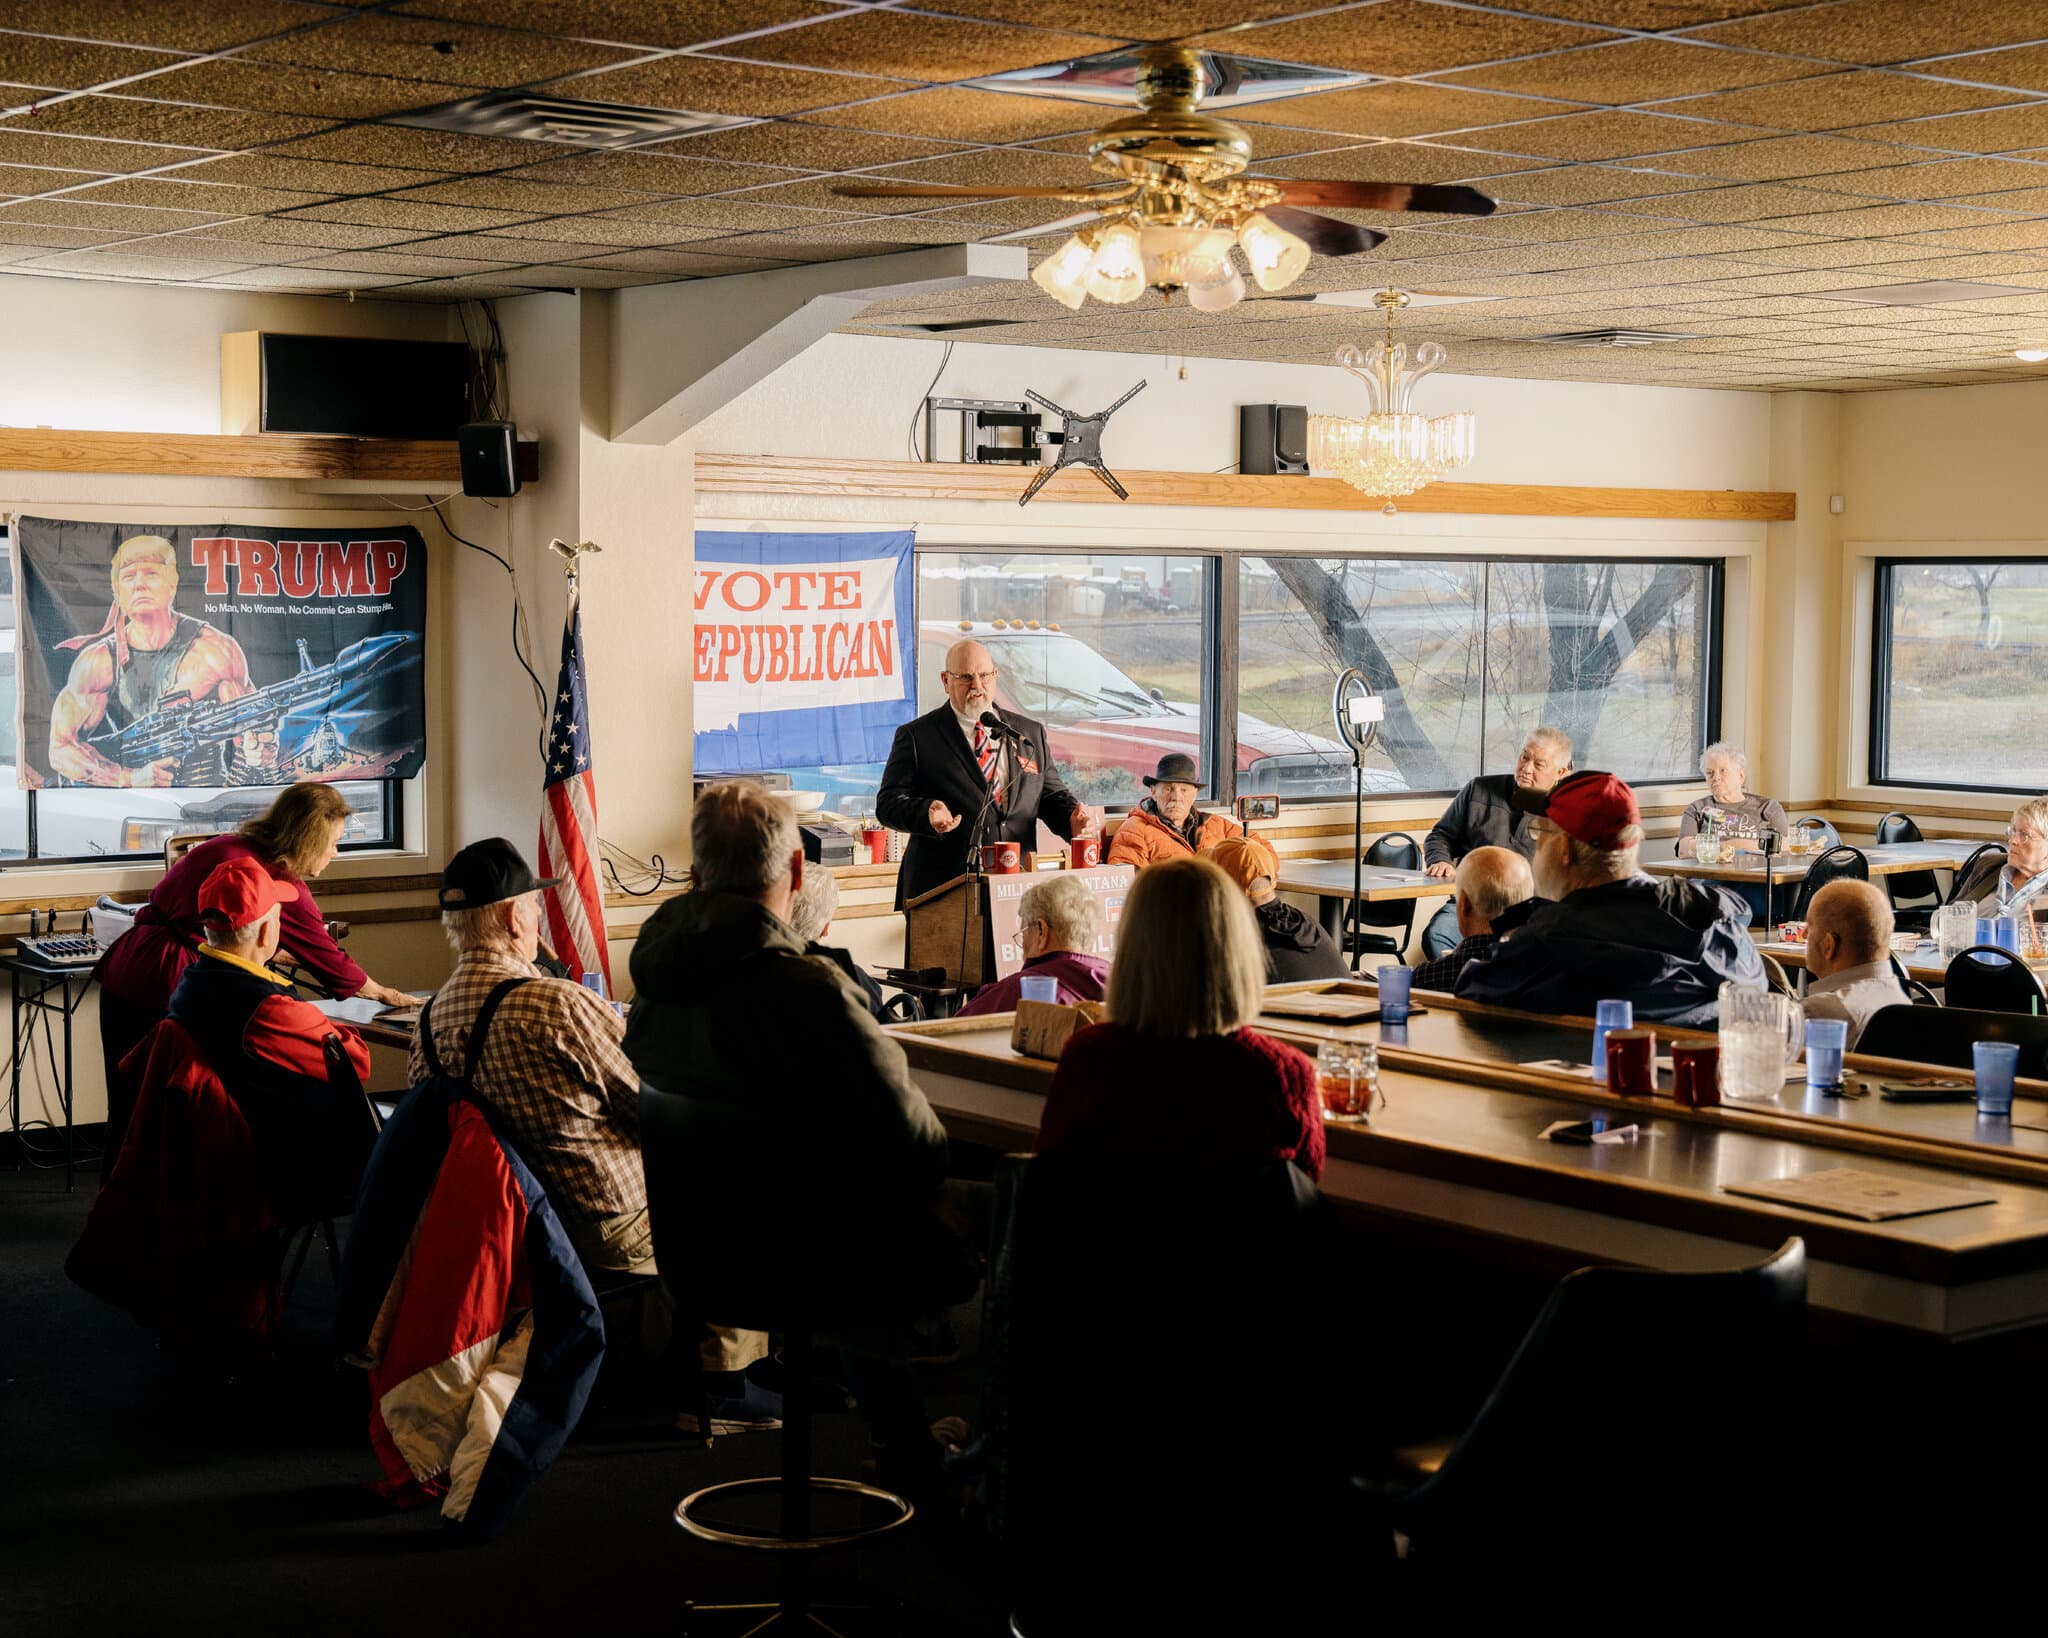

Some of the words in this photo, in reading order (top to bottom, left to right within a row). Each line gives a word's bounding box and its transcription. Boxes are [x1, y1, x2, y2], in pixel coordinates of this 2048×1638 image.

[191, 537, 407, 599] TRUMP
[205, 603, 217, 613] No
[219, 603, 239, 614] Man,
[240, 603, 252, 613] No
[254, 604, 287, 616] Woman,
[289, 605, 301, 614] No
[302, 605, 336, 615] Commie
[337, 605, 355, 615] Can
[357, 604, 381, 615] Stump
[694, 571, 862, 612] VOTE
[694, 619, 894, 684] EPUBLICAN
[1082, 875, 1129, 892] NTANA
